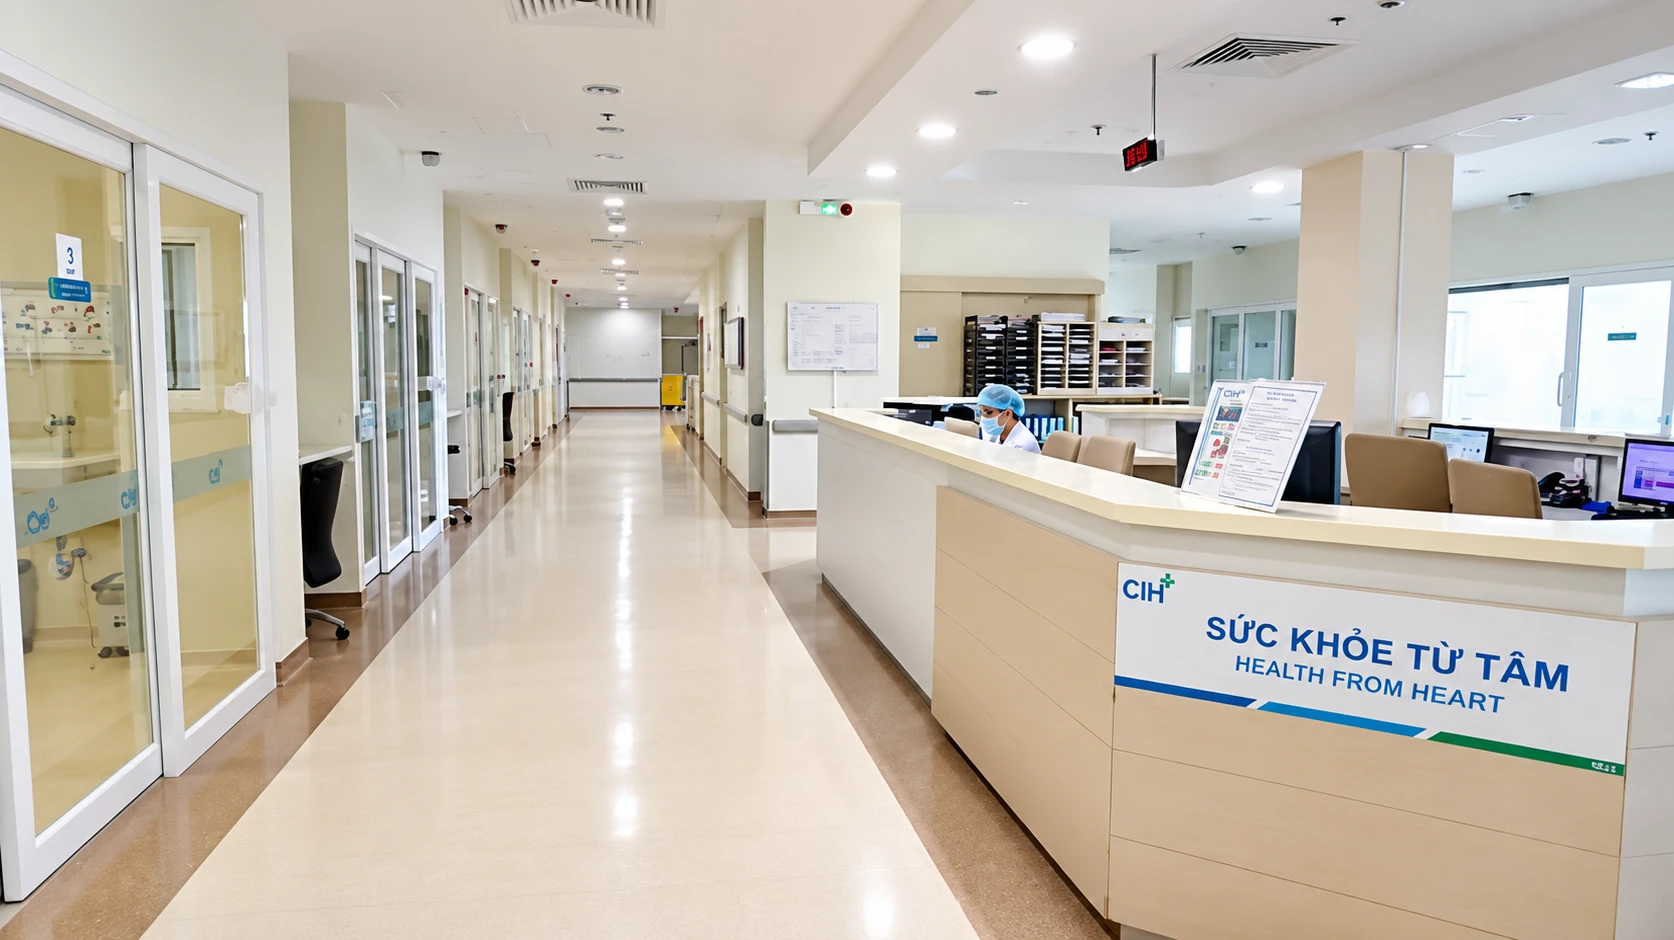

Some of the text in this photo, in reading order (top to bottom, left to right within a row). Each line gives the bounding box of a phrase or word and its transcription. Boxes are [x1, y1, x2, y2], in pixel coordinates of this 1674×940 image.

[66, 246, 74, 265] 3
[1206, 613, 1569, 693] SỨC KHỎE TỪ TÂM
[1235, 655, 1505, 713] HEALTH FROM HEART
